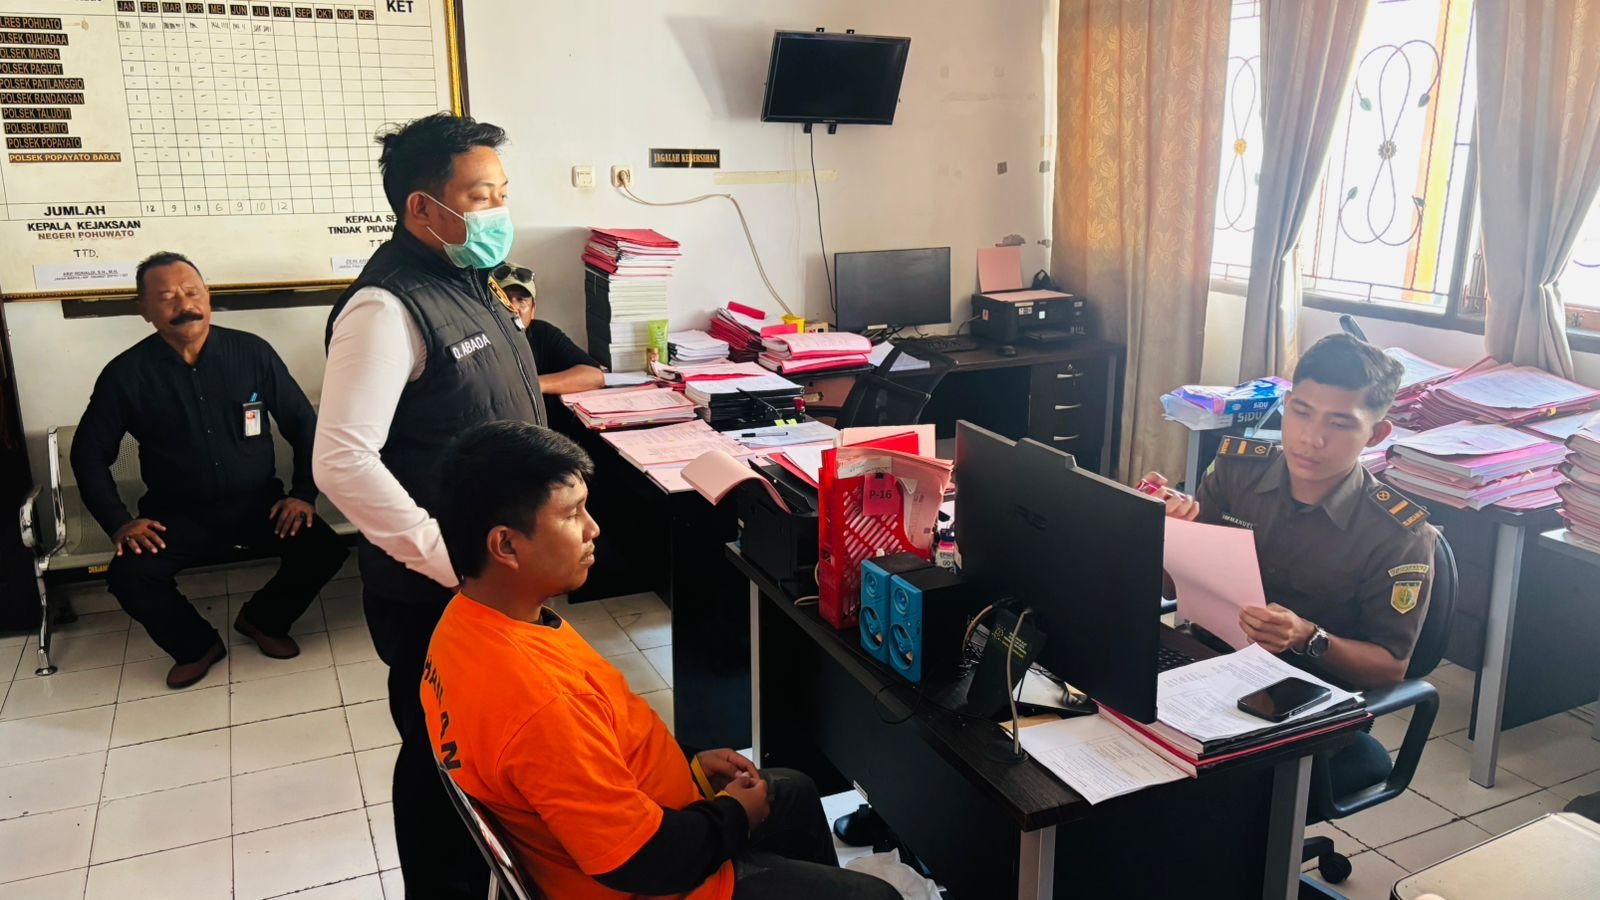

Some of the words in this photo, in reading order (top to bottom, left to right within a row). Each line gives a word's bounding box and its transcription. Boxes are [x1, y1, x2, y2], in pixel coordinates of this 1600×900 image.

[119, 1, 134, 11] JAN
[142, 2, 157, 12] FEB
[163, 2, 181, 12] MAR
[187, 3, 203, 13] APR
[210, 4, 224, 14] MEI
[231, 5, 247, 15] JUN
[254, 6, 268, 16] JUL
[274, 7, 290, 16] AGT
[296, 8, 311, 17] SEP
[317, 9, 332, 18] OKT
[338, 9, 354, 19] NOP
[359, 10, 374, 19] DES
[386, 0, 414, 13] KET
[23, 18, 61, 29] POHUATO
[26, 33, 67, 45] DUHIADAA
[29, 48, 59, 59] MARISA
[0, 63, 29, 74] OLSEK
[30, 63, 61, 75] PAGUAT
[33, 78, 84, 89] PATILANGGIO
[0, 93, 33, 104] POLSEK
[35, 93, 84, 104] RANDANGAN
[3, 108, 35, 119] POLSEK
[37, 108, 71, 119] TALUDITI
[5, 123, 37, 133] POLSEK
[39, 122, 67, 133] LEMITO
[8, 137, 40, 148] POLSEK
[41, 137, 81, 148] POPAYATO
[9, 154, 43, 162] POLSEK
[45, 153, 91, 161] POPAYATO
[92, 153, 121, 161] BARAT
[654, 153, 680, 163] JAGALAH
[44, 205, 106, 216] JUMLAH
[146, 204, 155, 213] 12
[215, 202, 224, 212] 6
[236, 201, 244, 212] 9
[256, 201, 266, 212] 10
[277, 201, 288, 211] 12
[345, 215, 382, 224] KEPALA
[27, 221, 72, 232] KEPALA
[77, 220, 142, 231] KEJAKSAAN
[328, 226, 362, 235] TINDAK
[38, 232, 75, 241] NEGERI
[79, 230, 135, 239] POHUWATO
[73, 249, 99, 259] TTD.
[869, 489, 893, 500] P-16
